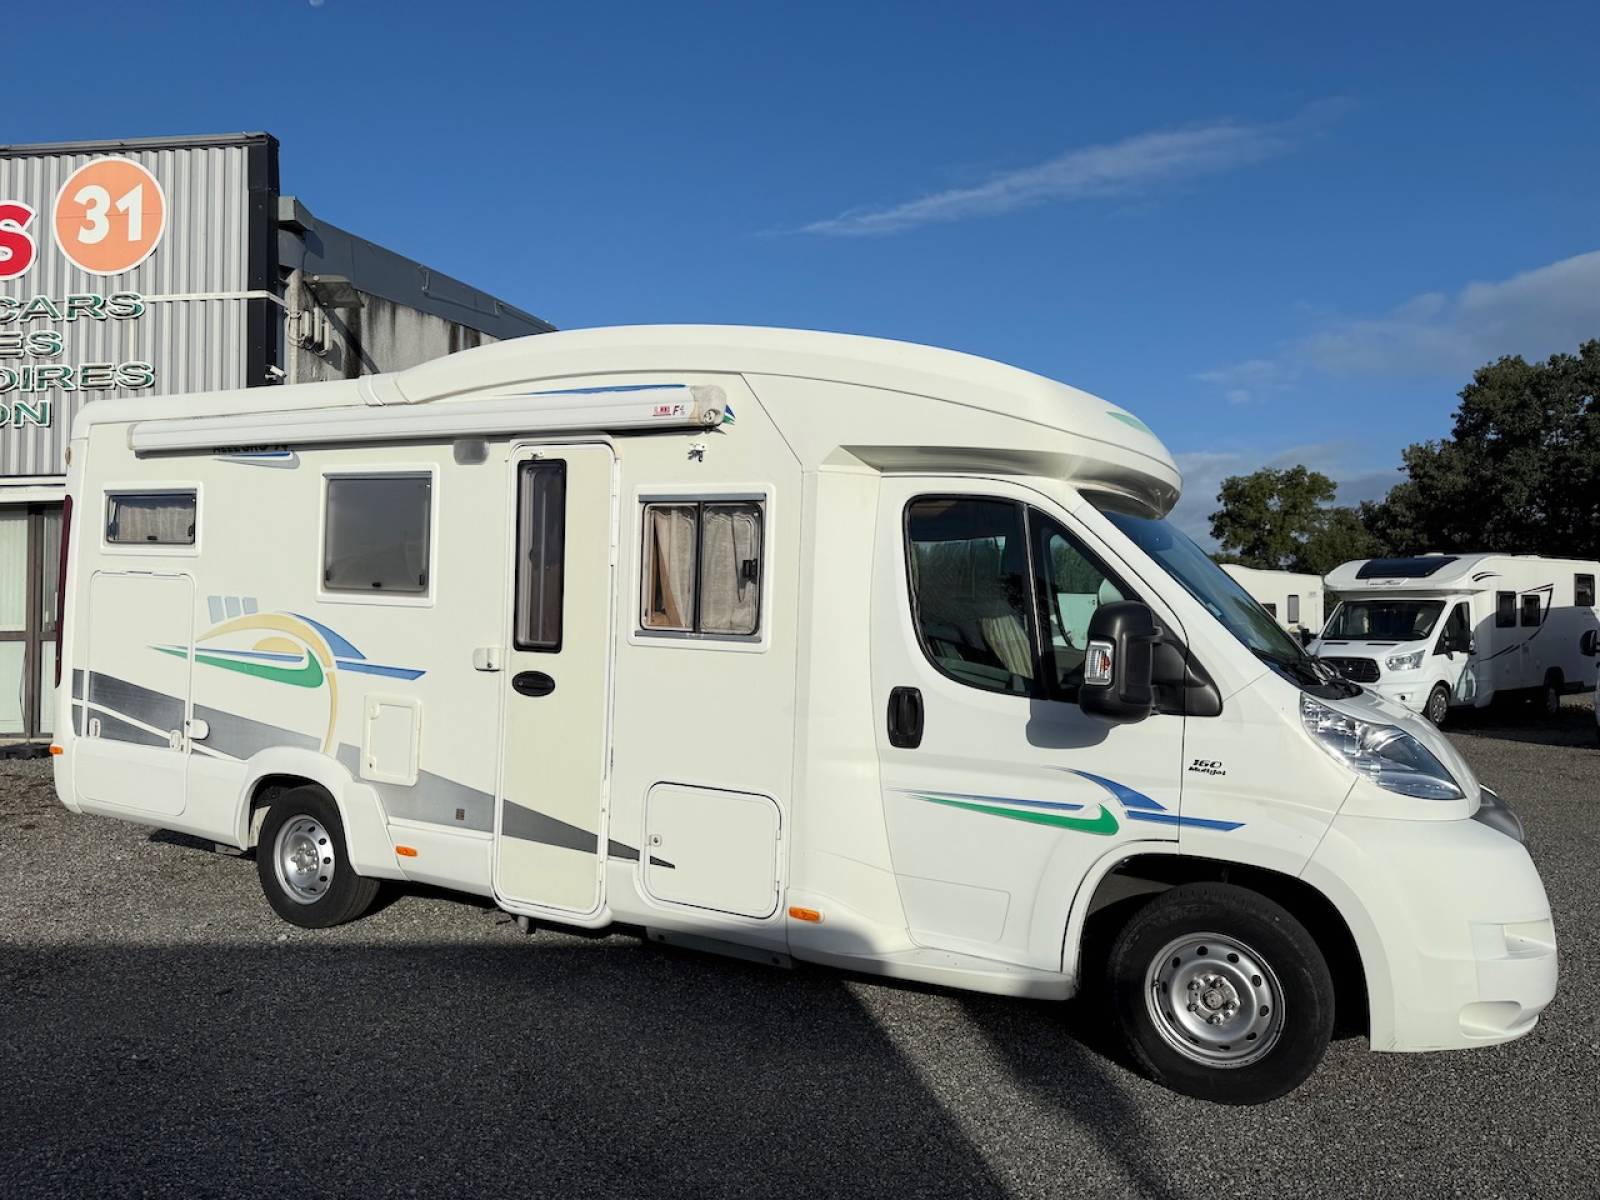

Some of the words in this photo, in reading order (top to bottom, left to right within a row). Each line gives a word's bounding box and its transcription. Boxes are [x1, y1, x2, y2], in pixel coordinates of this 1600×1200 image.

[73, 183, 144, 245] 31
[0, 330, 63, 358] ES
[0, 400, 51, 428] N
